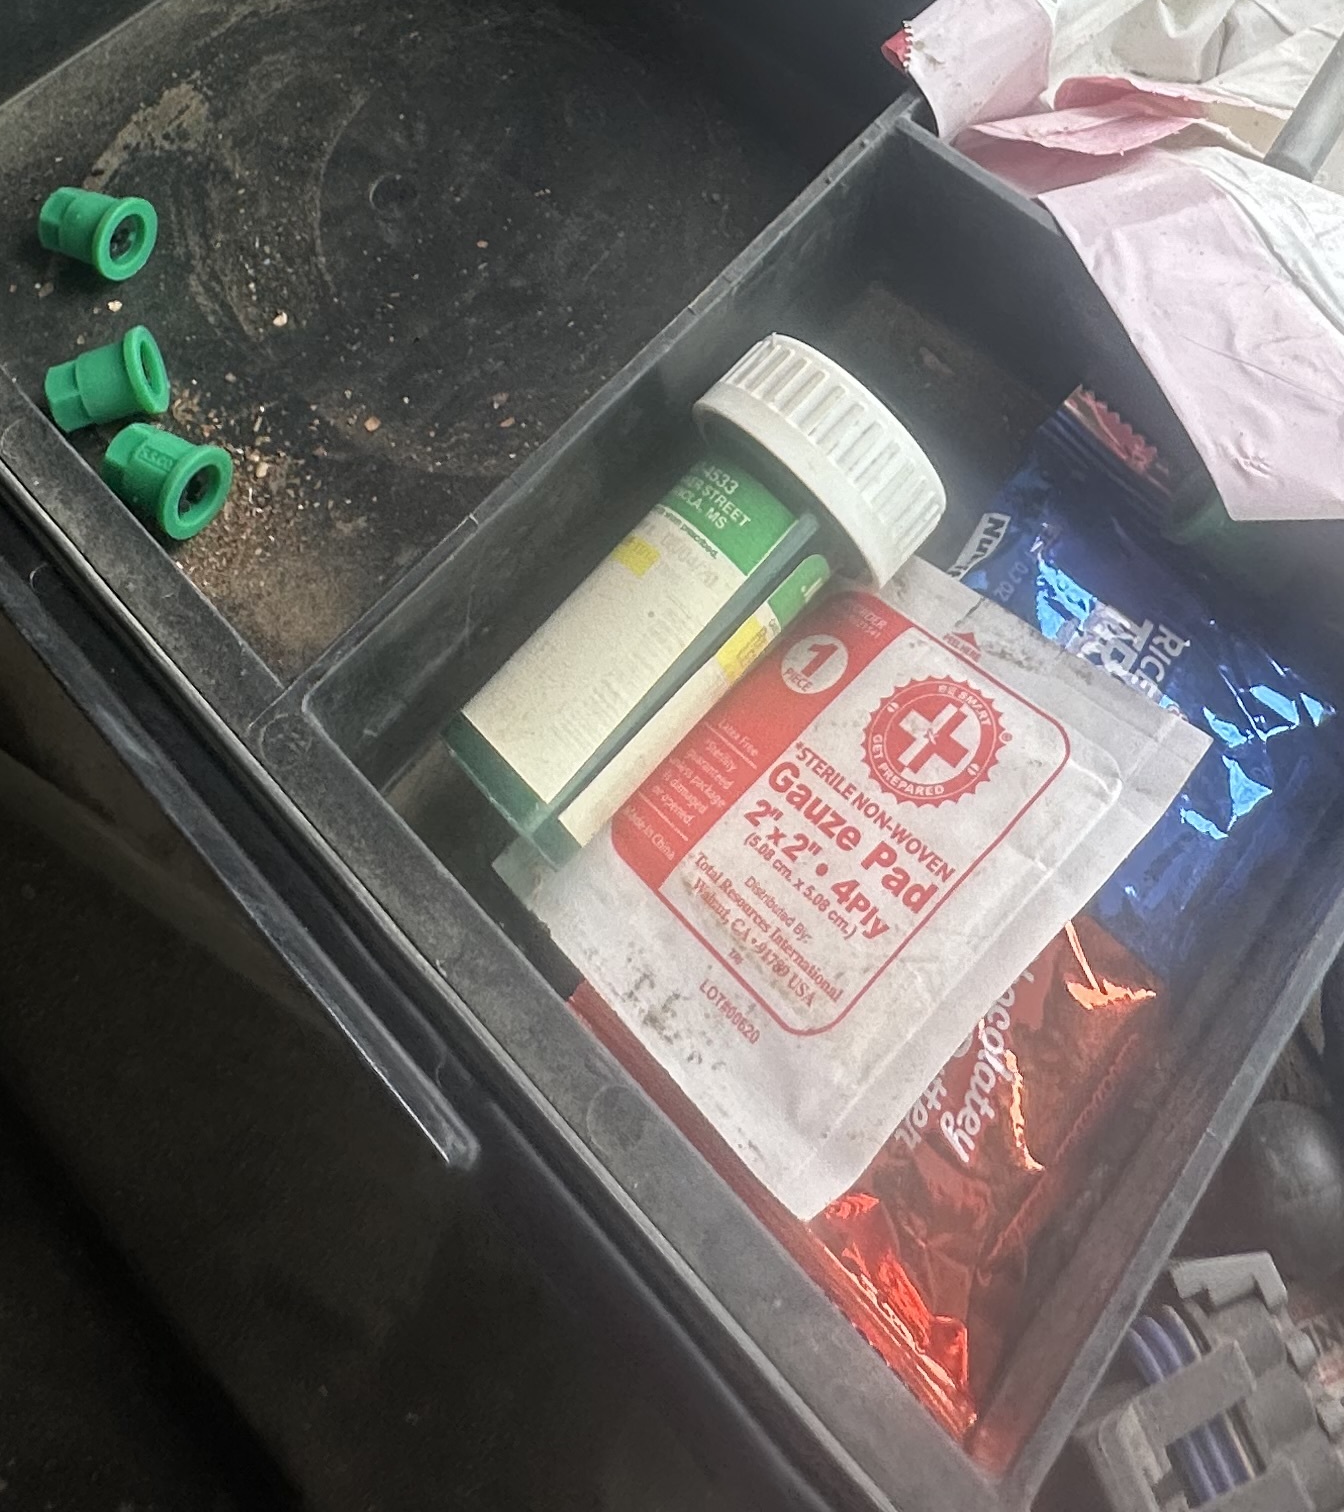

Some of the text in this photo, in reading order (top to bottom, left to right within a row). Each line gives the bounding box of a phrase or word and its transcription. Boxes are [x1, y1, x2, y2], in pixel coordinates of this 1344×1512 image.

[700, 481, 752, 530] STREET
[703, 505, 729, 530] MS
[783, 666, 813, 693] PIECE
[800, 642, 839, 678] 1
[1127, 622, 1189, 701] RICE
[955, 690, 993, 728] SMART
[737, 735, 762, 758] Free
[869, 733, 946, 799] GET PREPARED
[688, 773, 728, 811] package
[648, 830, 681, 861] China
[762, 755, 940, 916] Gauze Pad
[849, 786, 957, 887] NON-WOVEN
[740, 874, 797, 928] Distributed
[800, 883, 833, 915] 5.08
[822, 870, 899, 945] 4Ply
[690, 850, 848, 1004] Total Resources International
[784, 973, 820, 1009] USA
[941, 972, 1035, 1162] ocolatey
